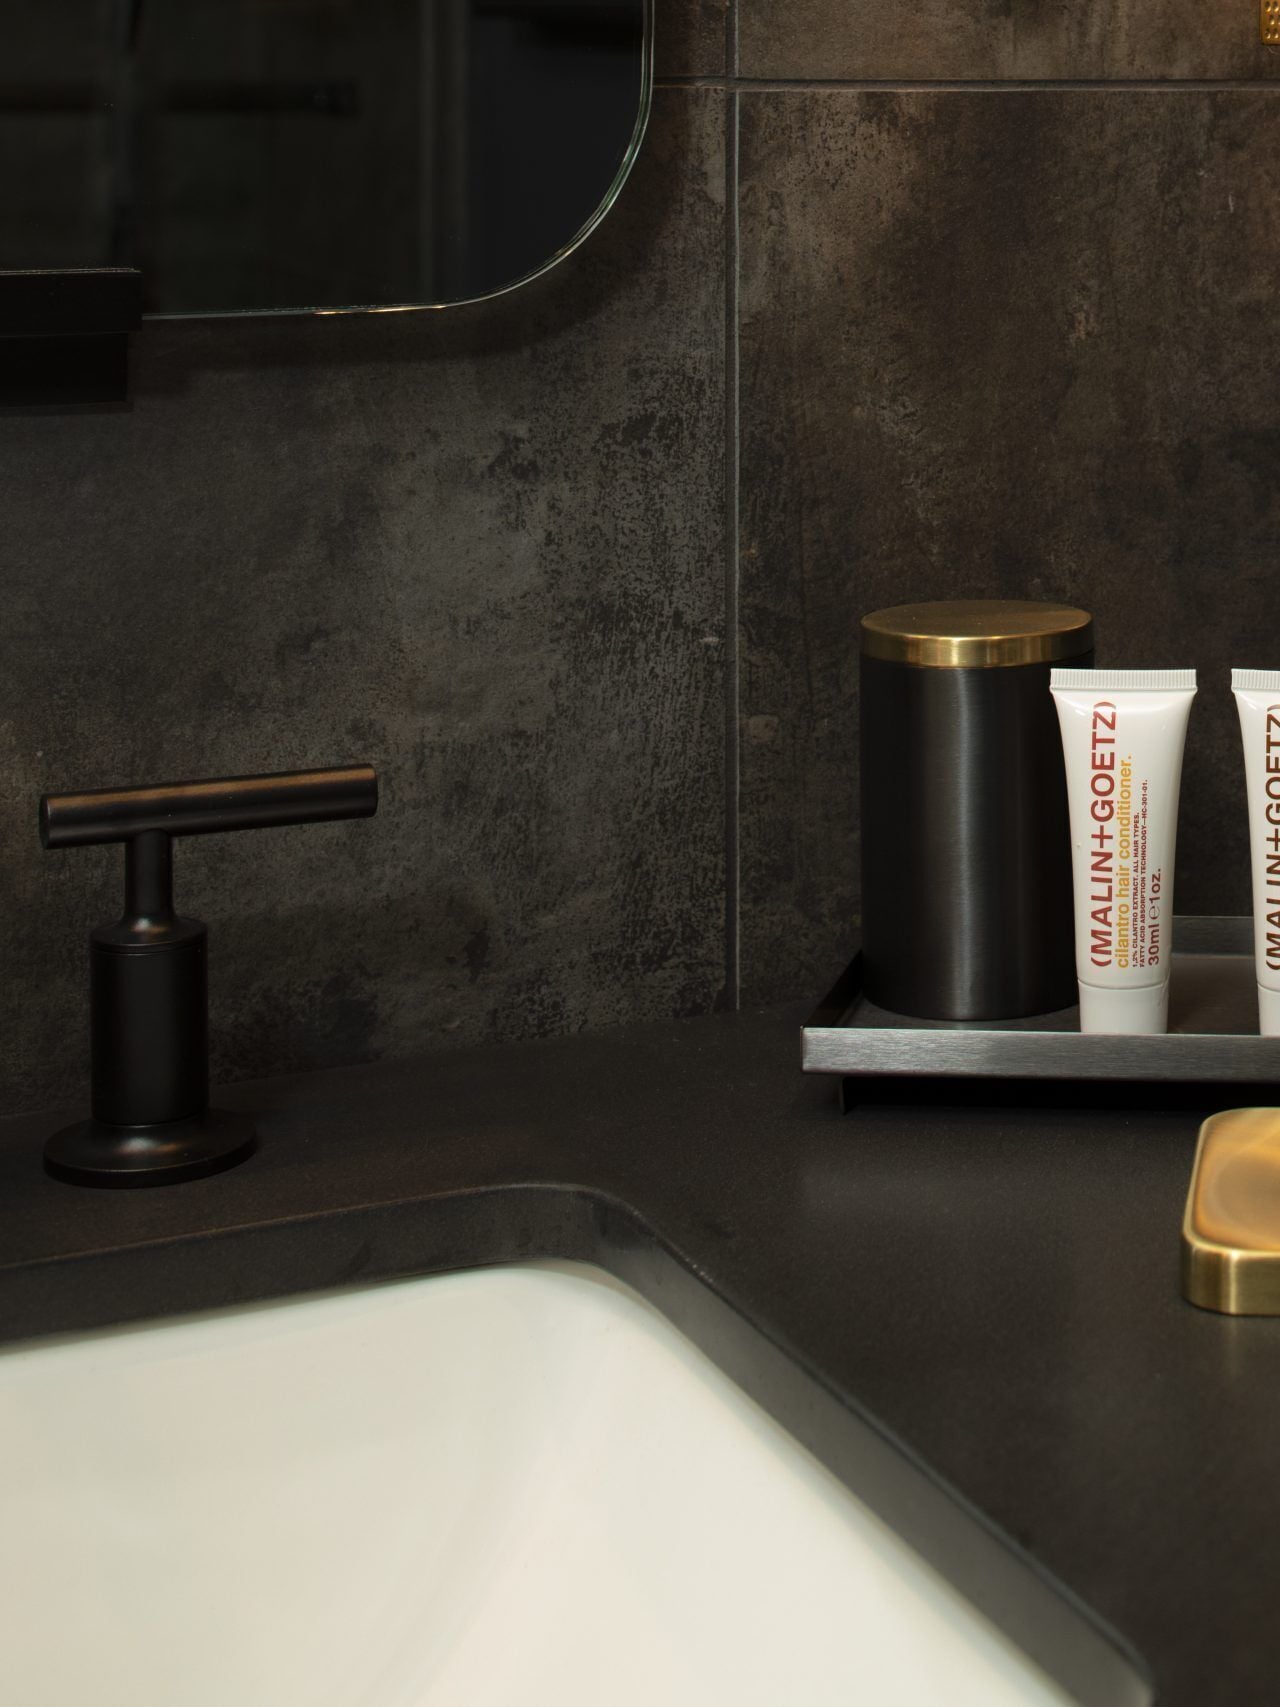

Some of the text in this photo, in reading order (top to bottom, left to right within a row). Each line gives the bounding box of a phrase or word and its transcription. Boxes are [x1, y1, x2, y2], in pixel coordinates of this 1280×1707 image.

[1090, 702, 1116, 967] (MALIN+GOETZ)
[1115, 755, 1132, 968] cilantro hair conditioner.
[1148, 923, 1160, 966] 30ml
